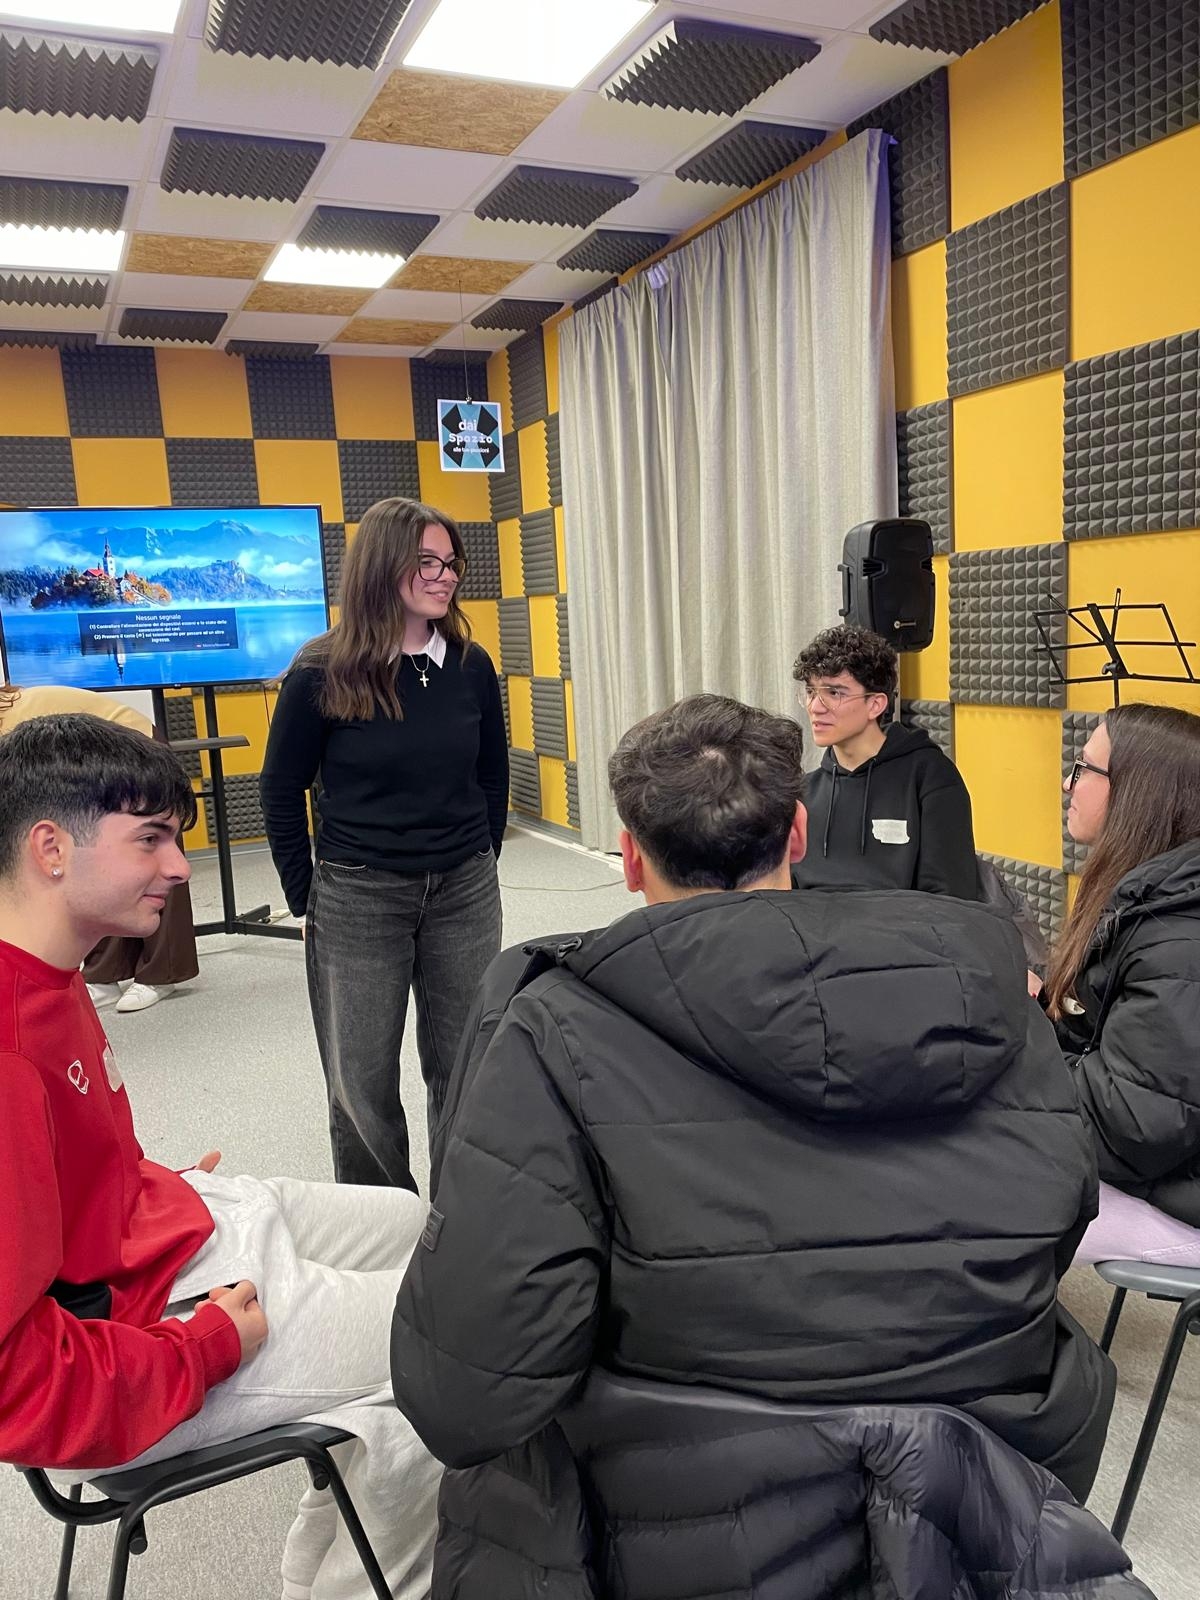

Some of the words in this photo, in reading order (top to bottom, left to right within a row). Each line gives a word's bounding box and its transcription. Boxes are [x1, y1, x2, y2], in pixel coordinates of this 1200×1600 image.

[458, 419, 477, 431] dai
[449, 433, 493, 446] Spazio
[158, 613, 181, 621] segnale
